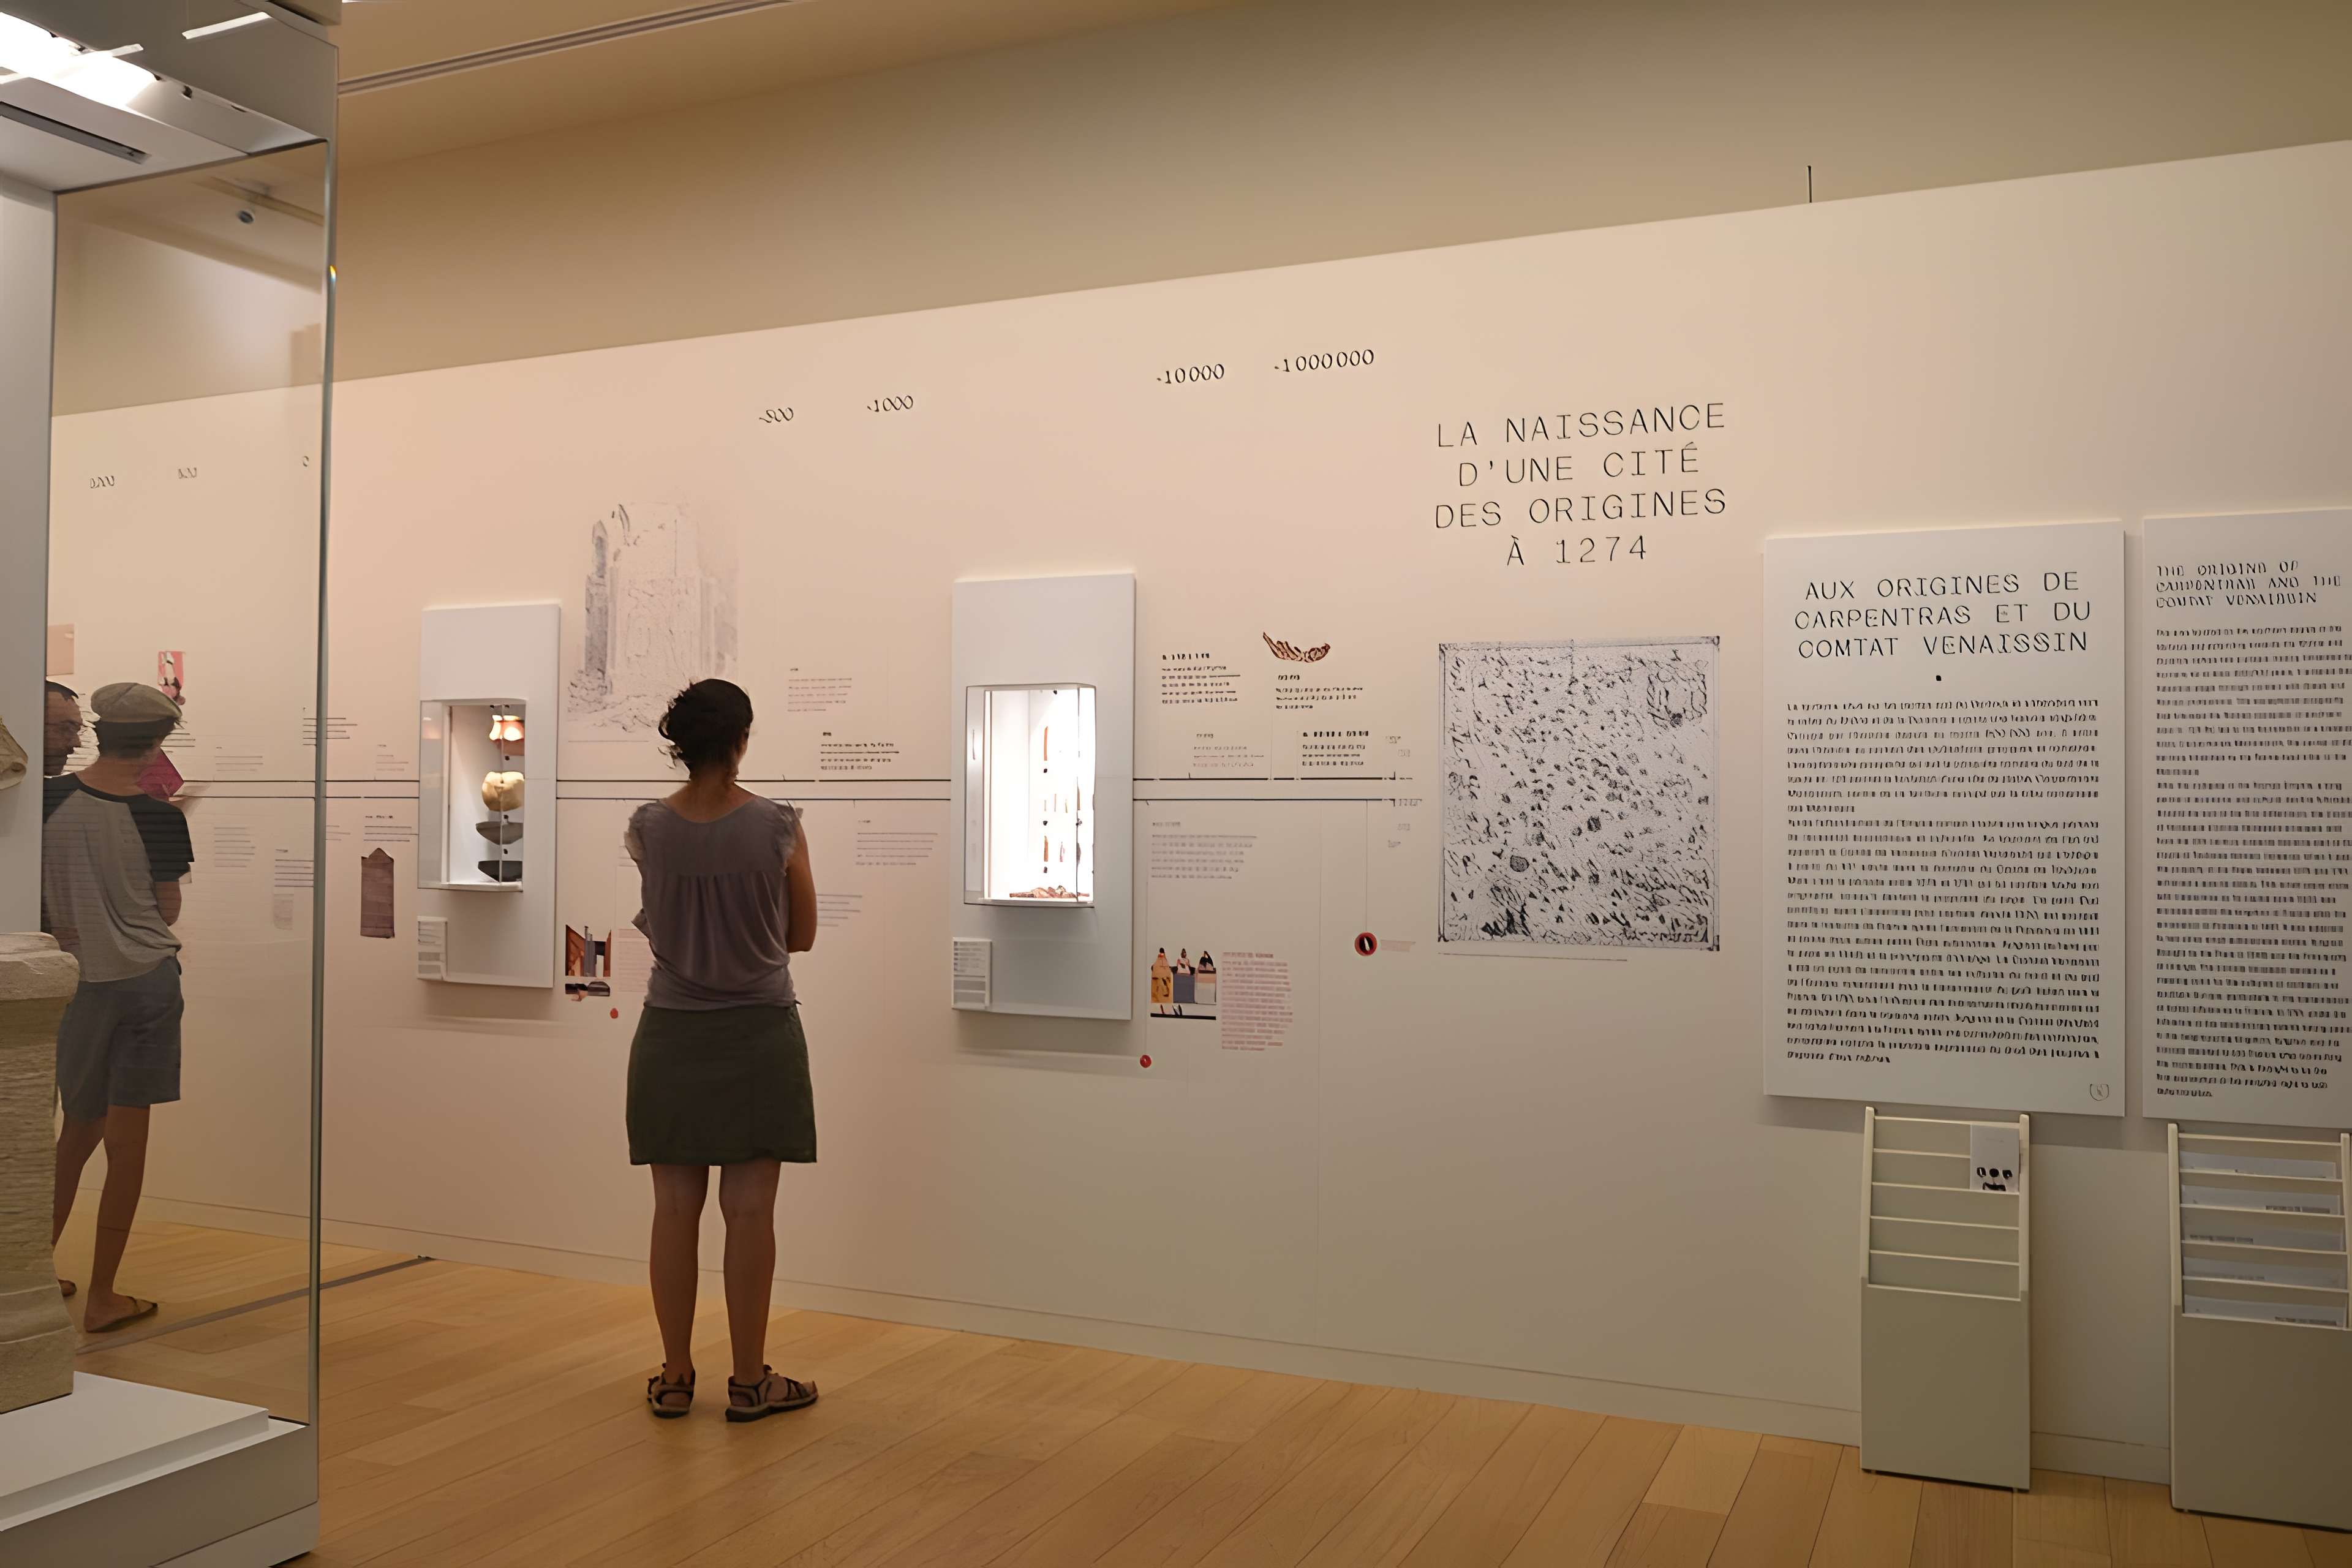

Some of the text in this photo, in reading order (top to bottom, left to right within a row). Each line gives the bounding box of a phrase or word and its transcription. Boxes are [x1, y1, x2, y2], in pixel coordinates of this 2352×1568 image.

[1438, 402, 1725, 448] LA NAISSANCE
[1459, 442, 1699, 487] D'UNE CITÉ
[1435, 488, 1726, 529] DES ORIGINES
[1506, 534, 1648, 567] À 1274
[1805, 571, 2080, 600] AUX ORIGINES DE
[1795, 600, 2091, 630] CARPENTRAS ET DU
[1798, 631, 2087, 659] COMTAT VENAISSIN
